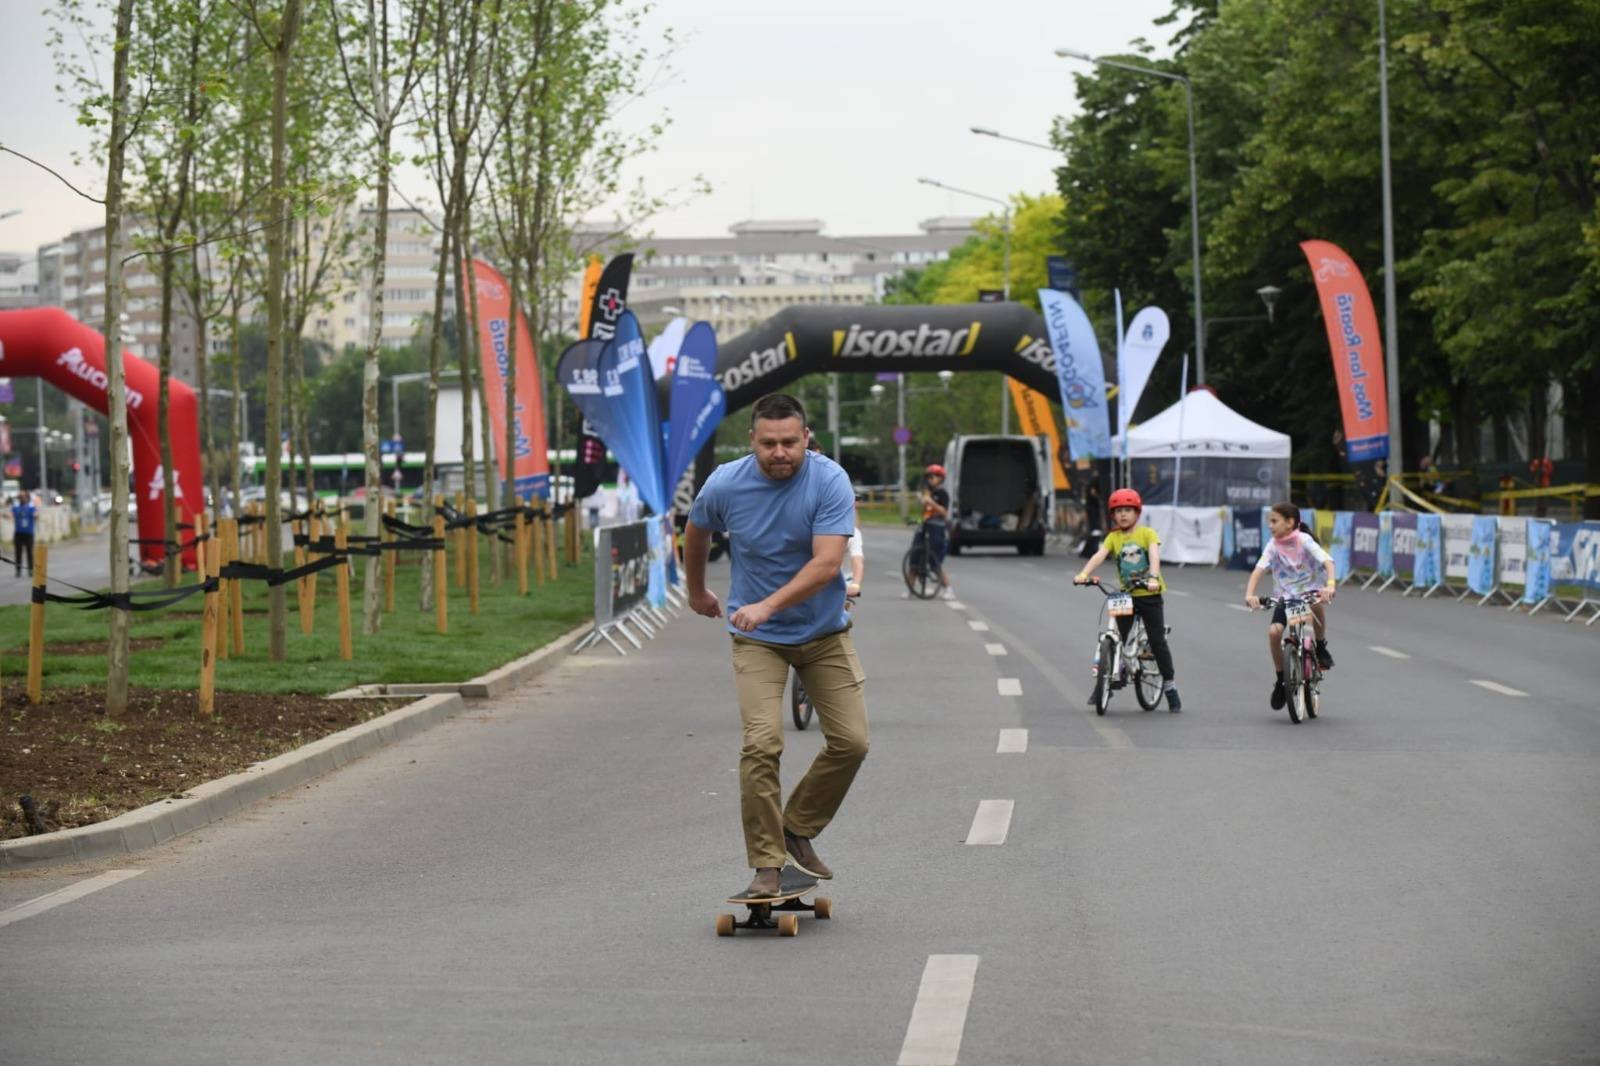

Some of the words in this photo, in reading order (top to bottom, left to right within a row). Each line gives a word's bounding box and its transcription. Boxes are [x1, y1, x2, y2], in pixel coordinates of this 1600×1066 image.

[841, 322, 968, 358] isostar
[56, 347, 144, 409] Aucn
[714, 341, 787, 391] ostar
[1290, 606, 1306, 615] 724
